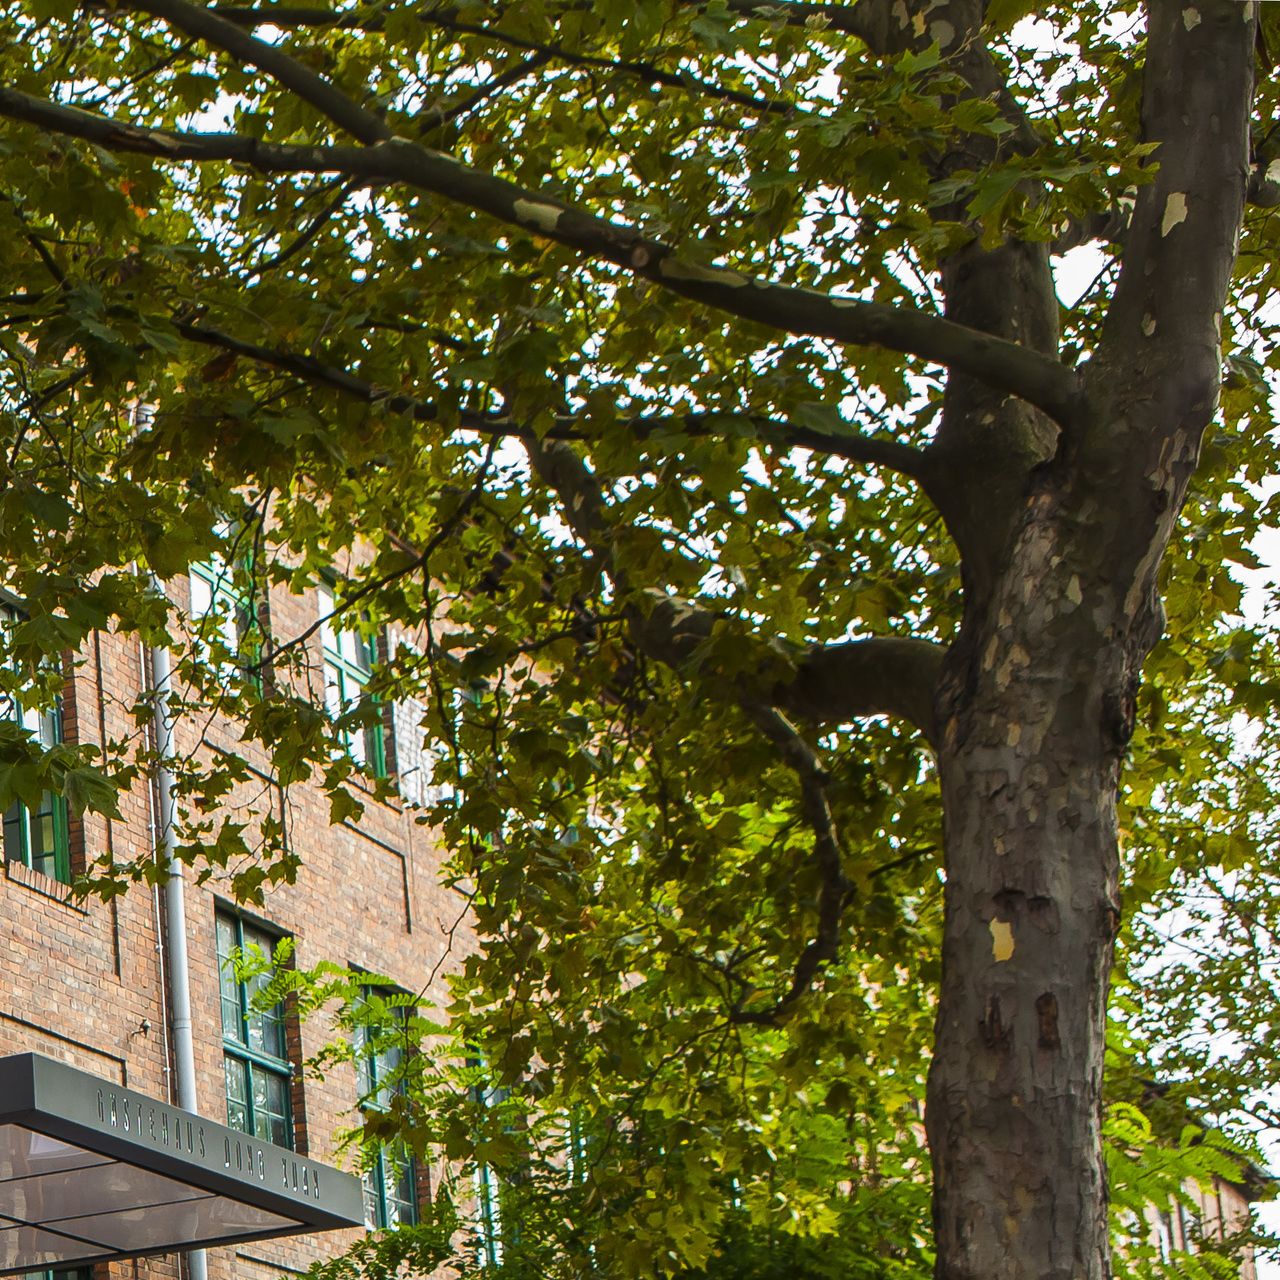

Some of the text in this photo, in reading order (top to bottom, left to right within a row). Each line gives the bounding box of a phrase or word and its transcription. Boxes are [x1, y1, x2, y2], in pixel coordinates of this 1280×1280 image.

[97, 1088, 320, 1200] GÄSTEHAUS DONG XUAN
